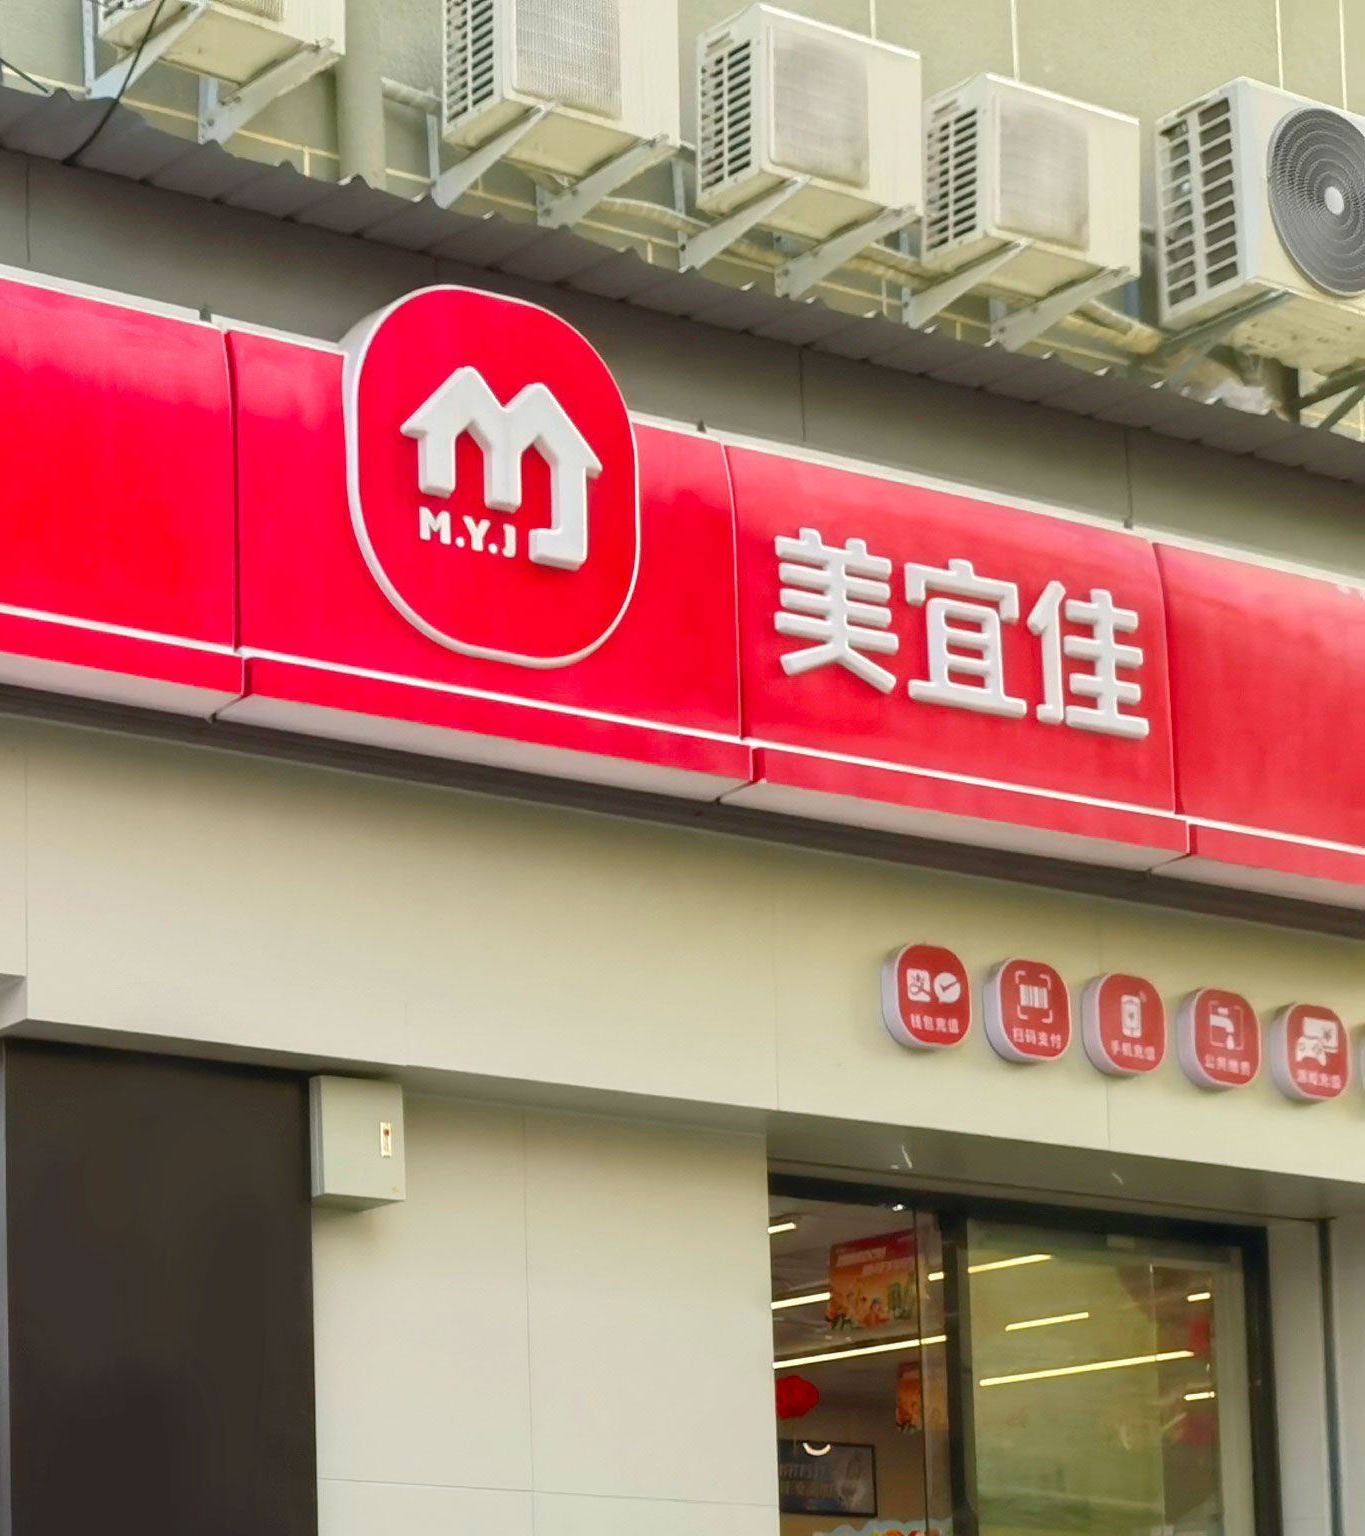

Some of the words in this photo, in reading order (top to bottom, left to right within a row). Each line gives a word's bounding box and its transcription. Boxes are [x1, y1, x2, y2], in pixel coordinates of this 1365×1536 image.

[419, 506, 517, 558] M.Y.J
[774, 526, 1150, 740] 美宜佳
[1012, 1026, 1062, 1050] 扫码支付
